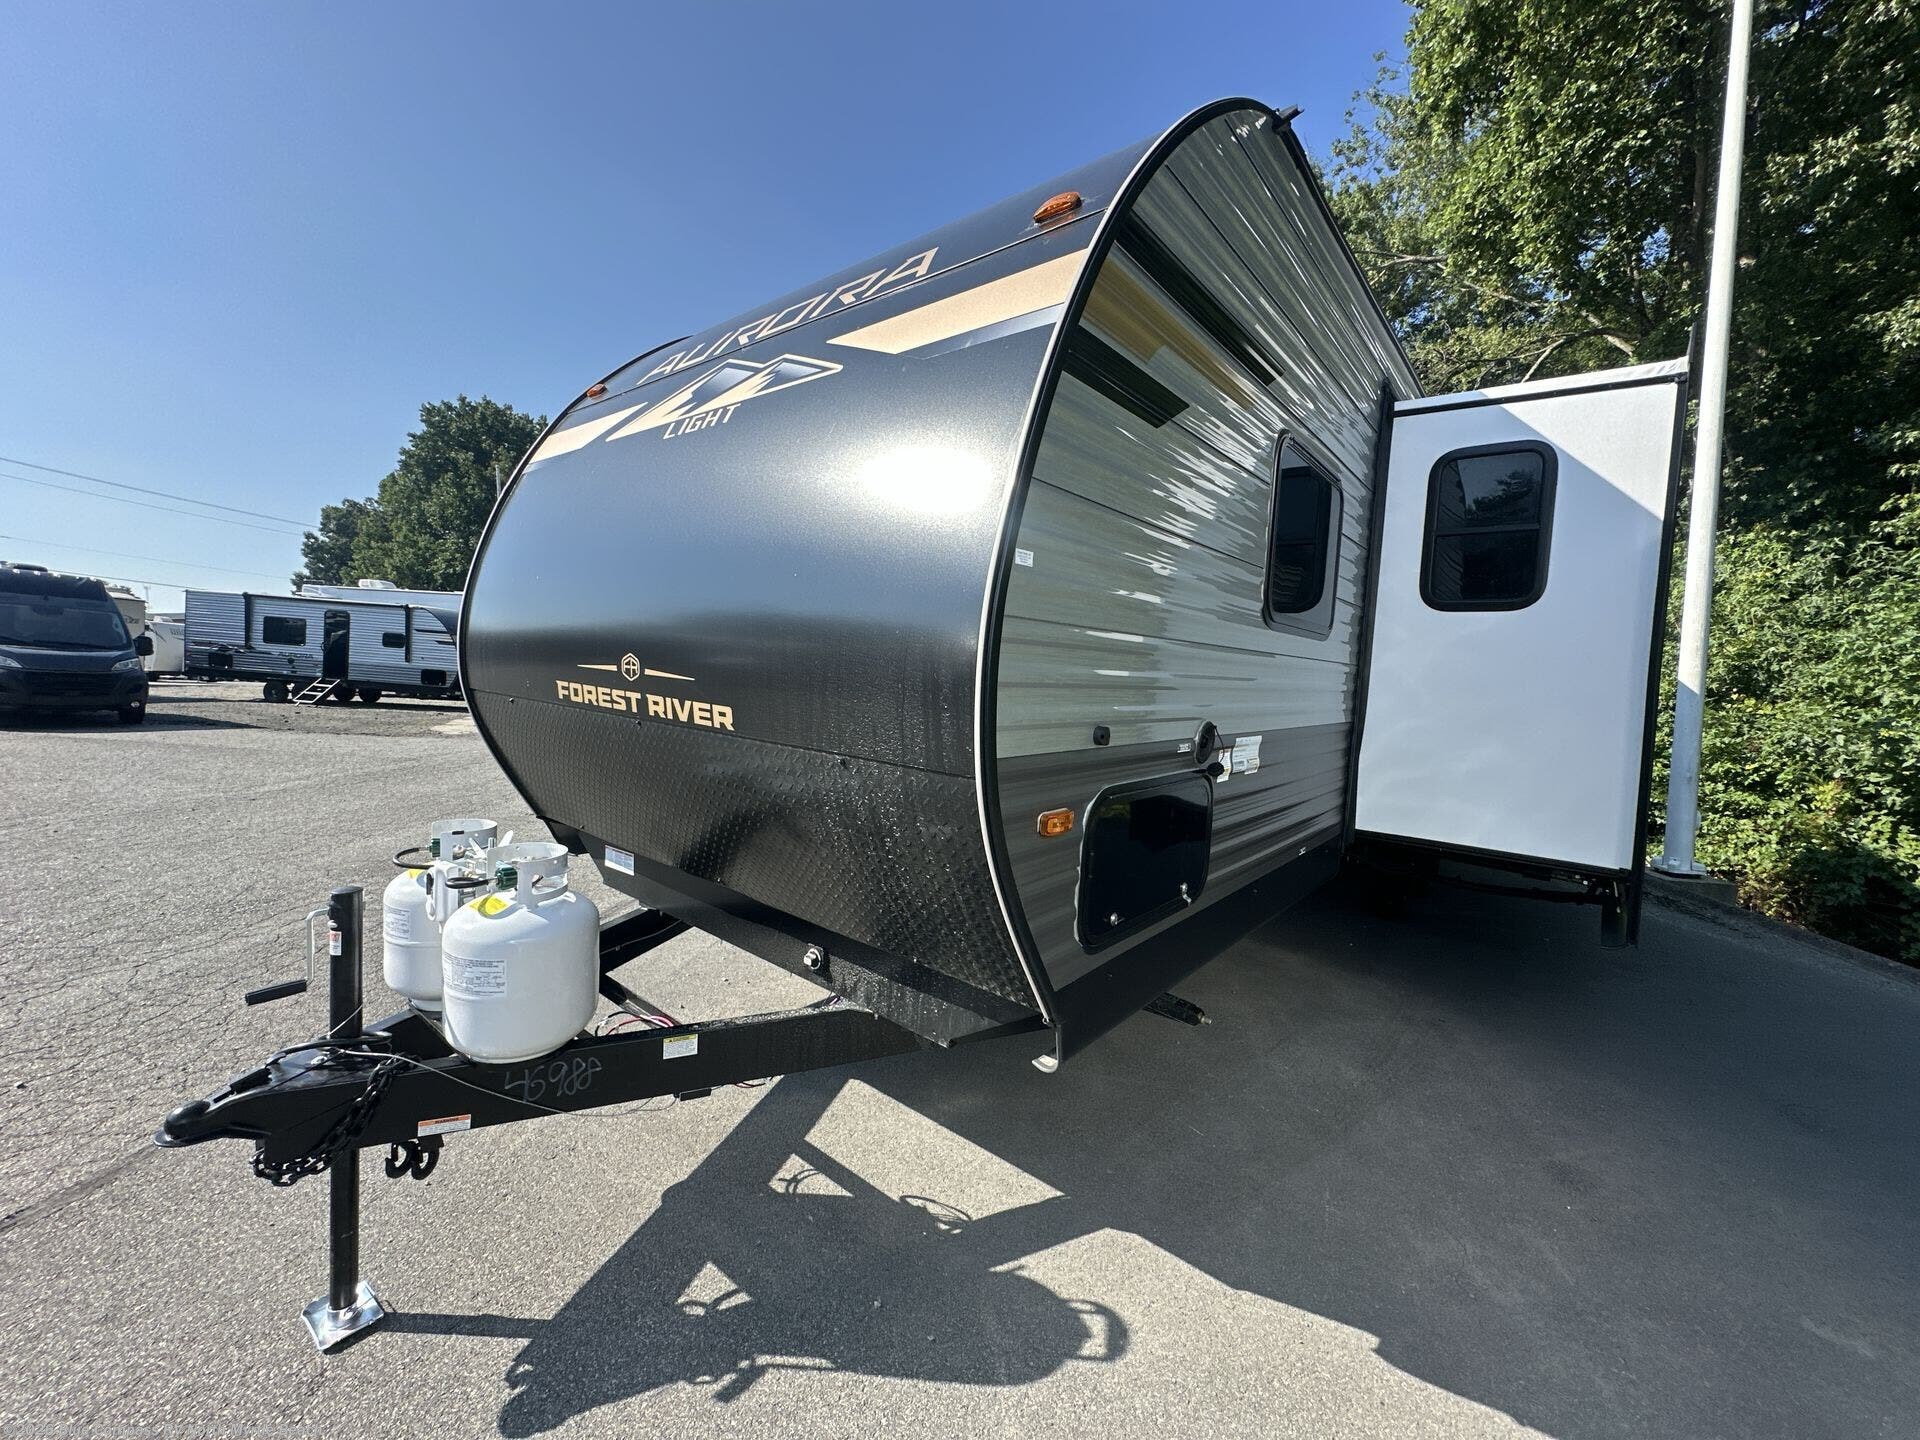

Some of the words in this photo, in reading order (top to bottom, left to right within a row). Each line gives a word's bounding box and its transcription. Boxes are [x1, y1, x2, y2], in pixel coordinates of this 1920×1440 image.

[636, 246, 939, 385] AURORA
[662, 403, 742, 440] LIGHT
[555, 679, 642, 714] FOREST
[646, 693, 735, 731] RIVER
